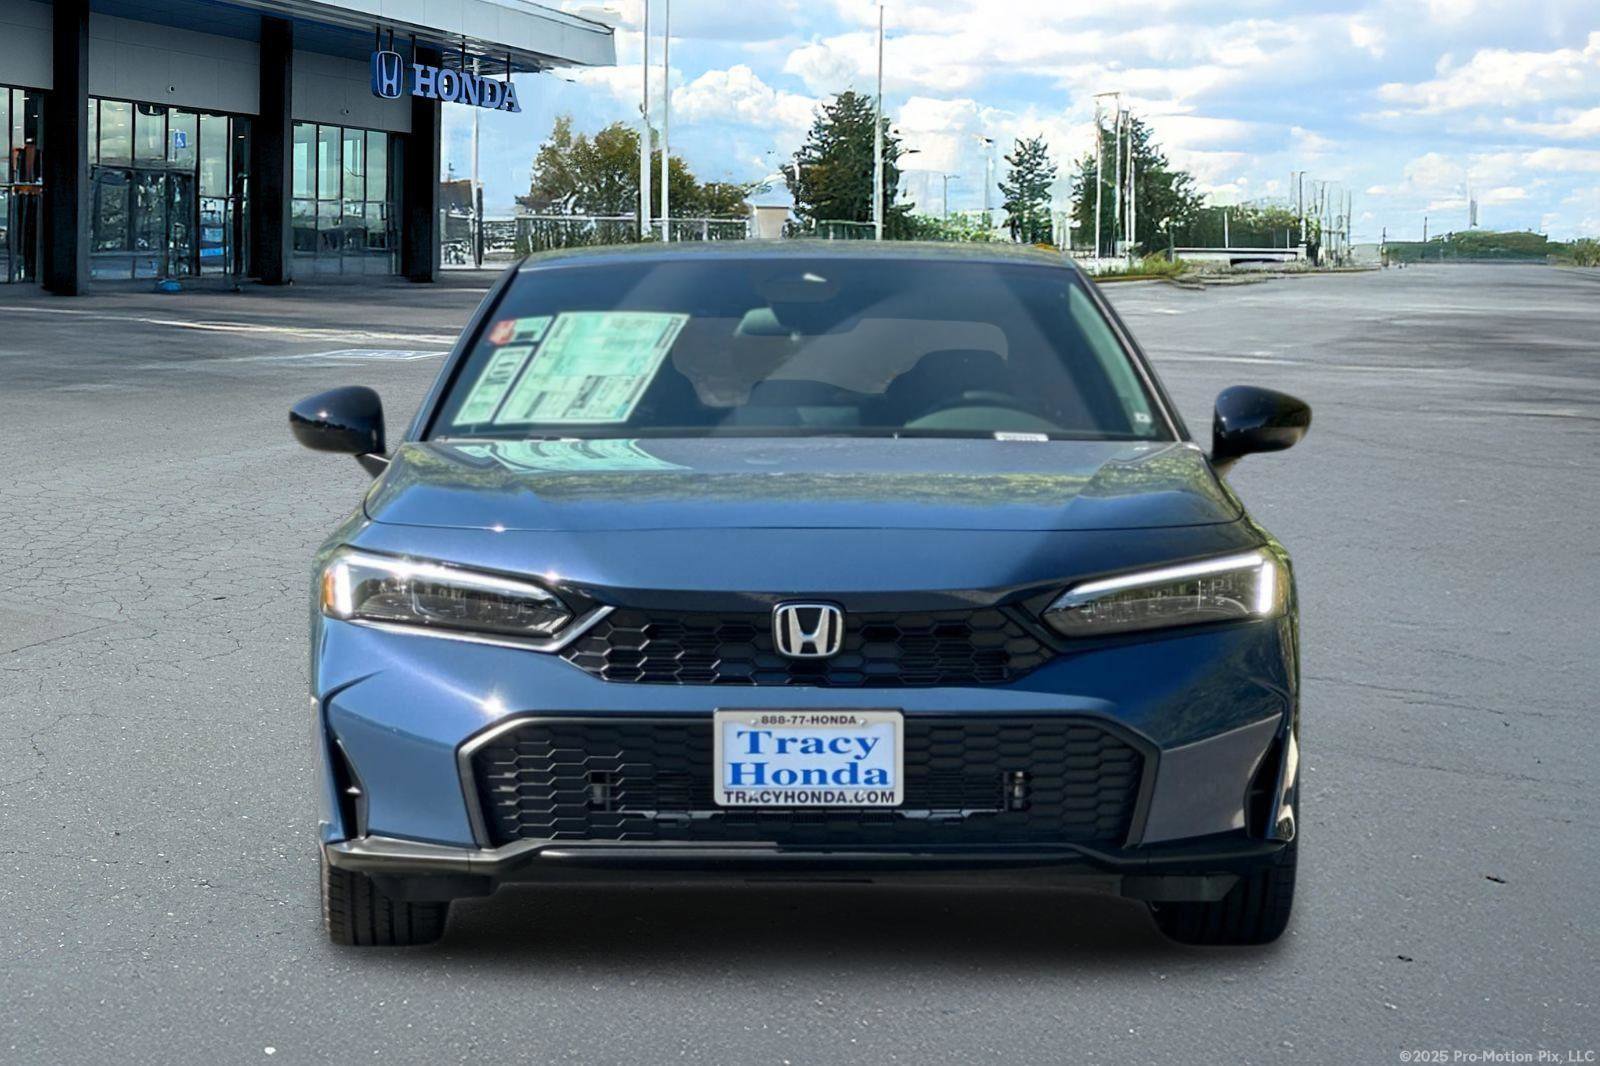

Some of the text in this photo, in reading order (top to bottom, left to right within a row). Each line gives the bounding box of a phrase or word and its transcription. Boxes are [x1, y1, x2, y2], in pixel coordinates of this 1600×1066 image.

[412, 63, 522, 113] HONDA
[761, 715, 857, 725] 888-77-HONDA
[736, 730, 881, 760] Tracy
[728, 762, 891, 786] Honda
[724, 791, 895, 804] TRACYHONDA.COM
